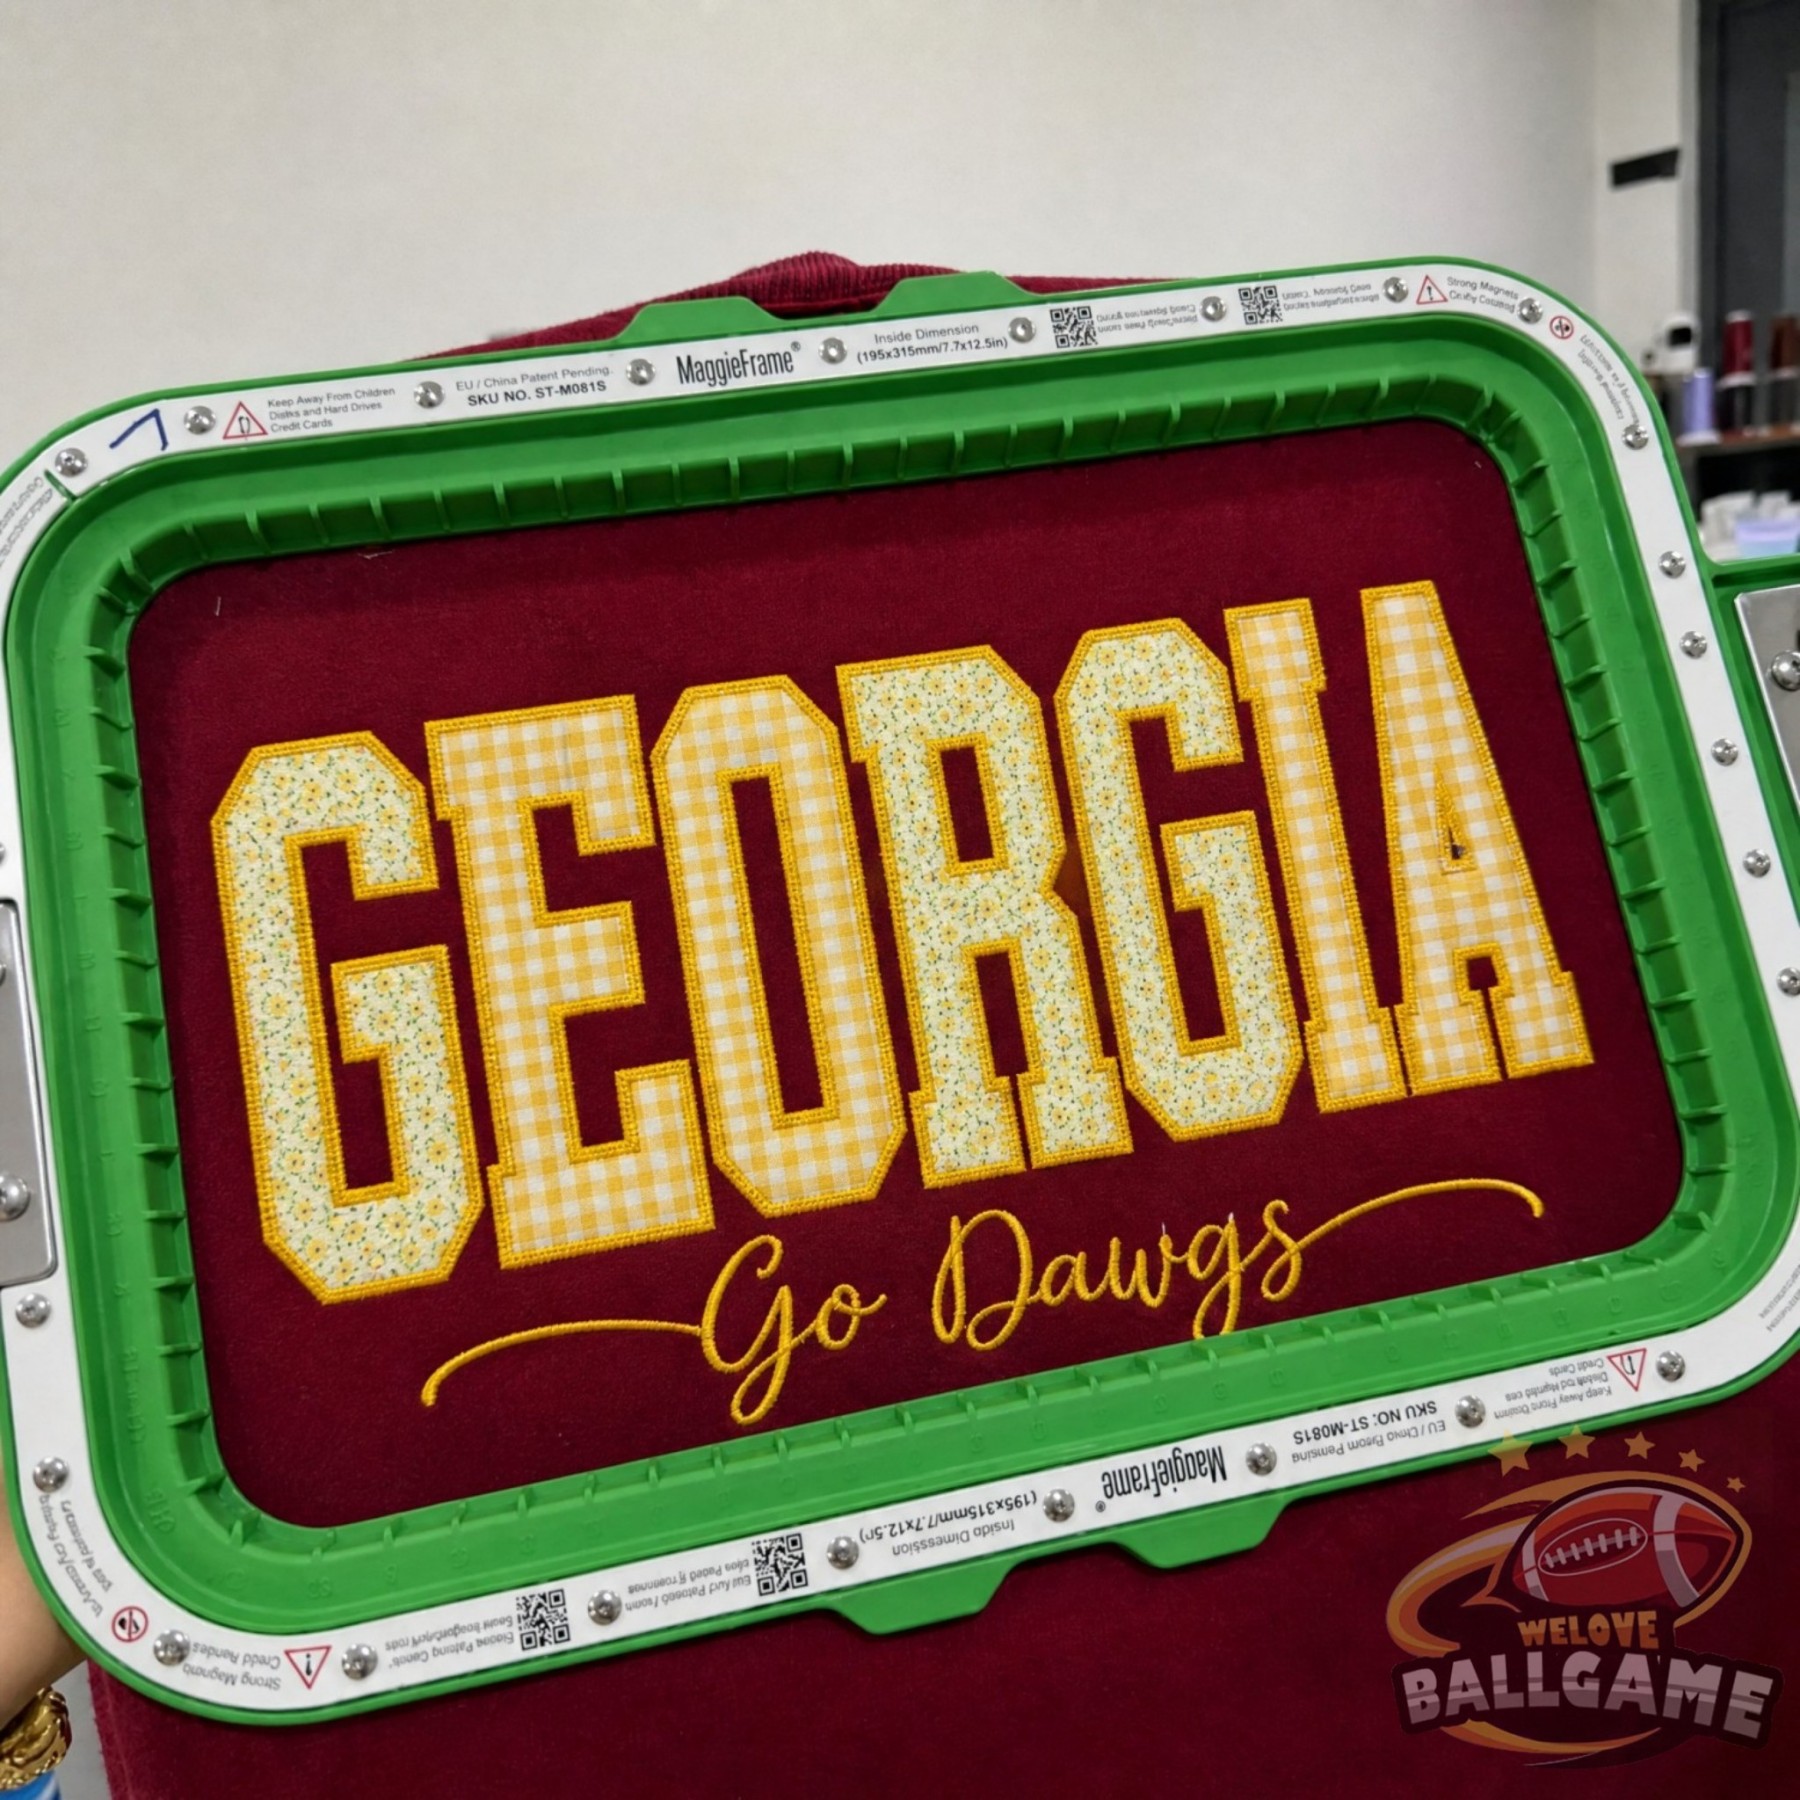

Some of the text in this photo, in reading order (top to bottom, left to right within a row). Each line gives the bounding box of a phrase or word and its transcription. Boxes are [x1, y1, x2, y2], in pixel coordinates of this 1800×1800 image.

[1447, 276, 1519, 300] Strong Magnets
[874, 322, 980, 345] Inside Dimension
[455, 380, 474, 392] EU
[483, 374, 518, 389] China
[521, 370, 559, 384] Patent
[267, 387, 396, 408] Keep Away From Children
[467, 380, 607, 407] SKU NO. ST-M081S
[302, 406, 322, 417] and
[324, 403, 349, 415] Hard
[350, 400, 384, 413] Drives
[270, 418, 334, 434] Credit Cards
[209, 579, 1595, 1305] GEORGIA
[701, 1198, 1303, 1425] Go Dawgs
[1548, 1357, 1605, 1377] Credit Cards
[1558, 1393, 1585, 1406] Away
[1586, 1386, 1613, 1401] Keep
[1405, 1400, 1438, 1419] SKU
[1292, 1416, 1369, 1445] ST-M081S
[1428, 1420, 1447, 1433] EU
[241, 1671, 281, 1691] Strong
